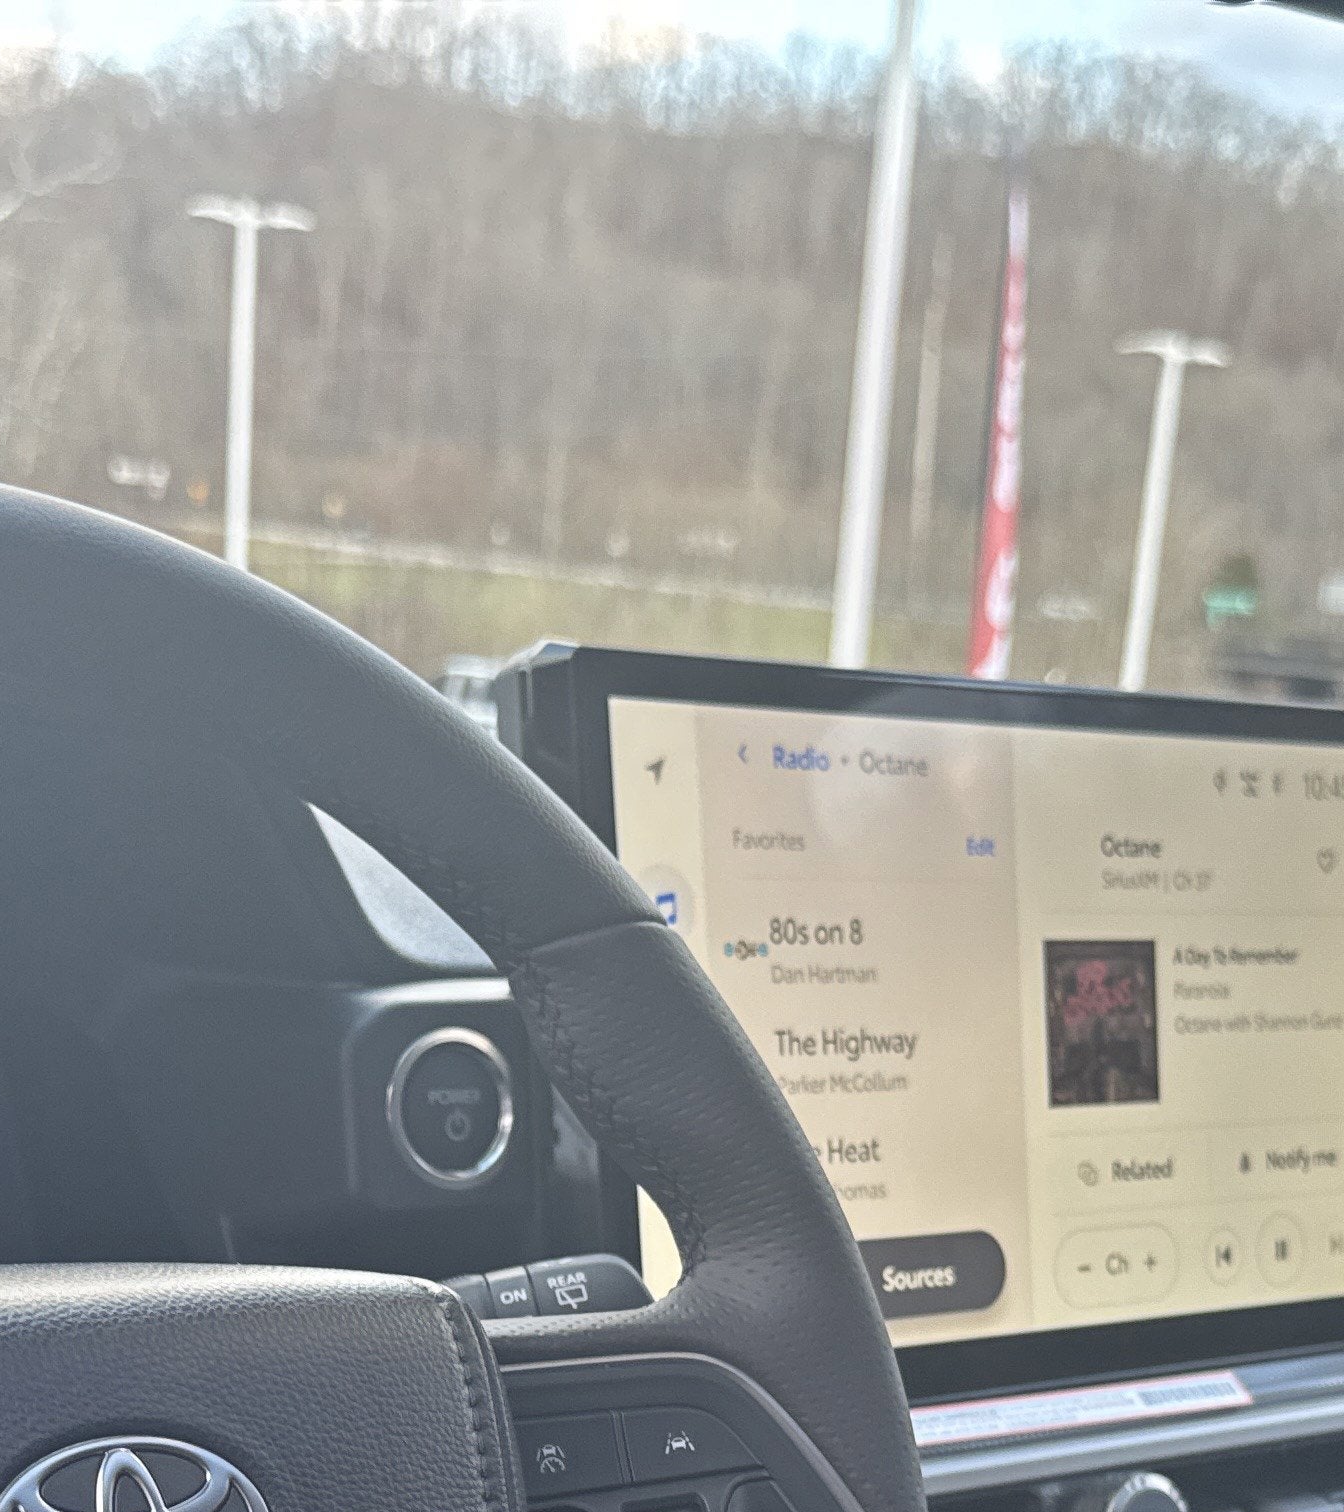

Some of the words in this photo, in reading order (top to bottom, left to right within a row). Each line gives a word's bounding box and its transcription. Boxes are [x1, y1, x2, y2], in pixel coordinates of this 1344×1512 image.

[772, 743, 831, 771] Radio
[859, 749, 929, 777] Octane
[732, 827, 806, 851] Favorites
[965, 834, 996, 857] Edit
[1100, 833, 1163, 859] Octane
[769, 917, 810, 946] 80s
[814, 924, 845, 946] on
[849, 918, 864, 946] 8
[771, 963, 805, 984] Dan
[808, 963, 878, 985] Hartman
[775, 1028, 817, 1056] The
[821, 1027, 918, 1061] Highway
[830, 1070, 909, 1094] McCollum
[827, 1138, 881, 1164] Heat
[1111, 1155, 1174, 1182] Related
[546, 1271, 588, 1291] REAR
[881, 1265, 956, 1293] Sources
[499, 1288, 528, 1306] ON
